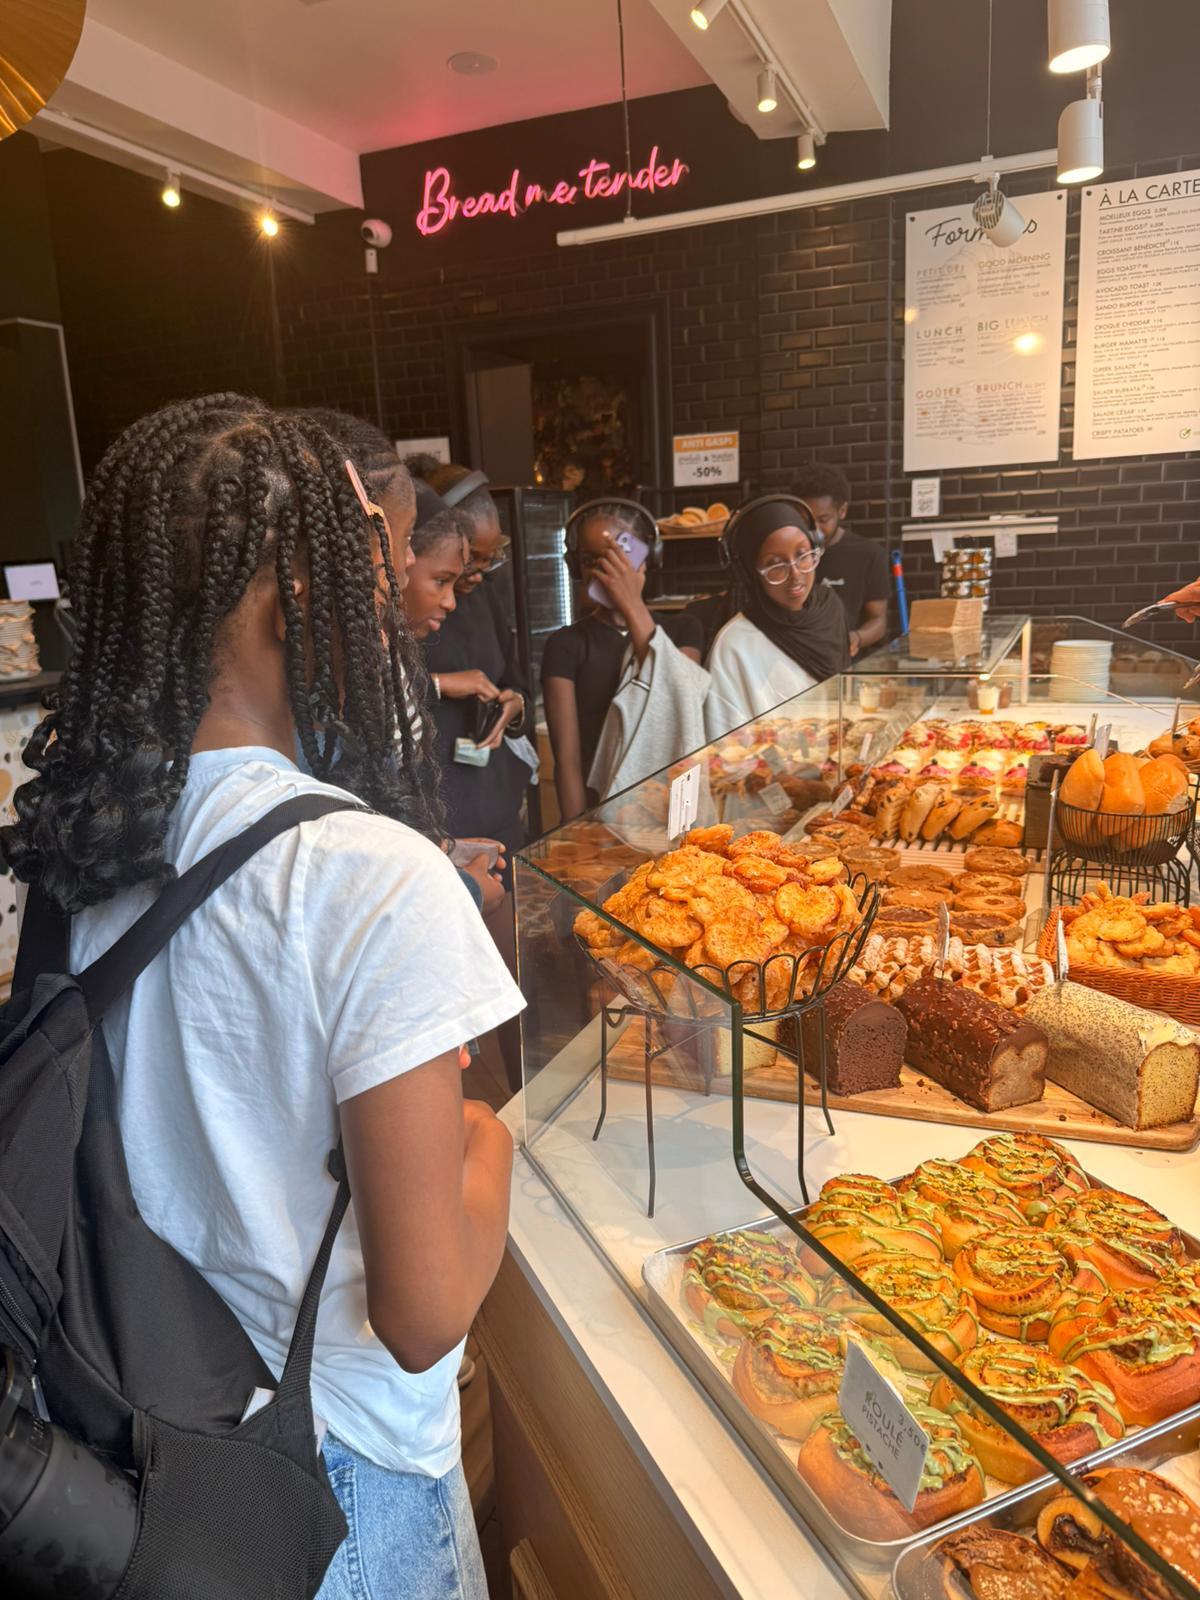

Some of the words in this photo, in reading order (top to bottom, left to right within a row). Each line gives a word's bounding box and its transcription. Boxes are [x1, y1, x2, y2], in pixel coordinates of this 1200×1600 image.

[415, 167, 519, 235] Bread
[525, 181, 576, 206] me
[578, 145, 690, 200] tender
[1100, 188, 1112, 207] À
[1119, 188, 1139, 204] LA
[1145, 178, 1200, 200] CARTE
[1099, 212, 1131, 221] MOELLEUX
[1132, 208, 1151, 217] EGGS
[925, 217, 1038, 247] Forms
[1099, 226, 1123, 235] TARTINE
[1124, 223, 1143, 231] EGGS
[1097, 246, 1132, 256] CROISSANT
[978, 259, 1006, 269] GOOD
[1008, 252, 1051, 264] MORNING
[916, 265, 945, 278] PETIT
[1116, 264, 1136, 272] TOAST
[1096, 285, 1128, 294] AVOCADO
[1129, 282, 1150, 290] TOAST
[1095, 303, 1118, 311] SANDO
[977, 320, 999, 332] BIG
[1094, 322, 1120, 331] CROQUE
[1121, 319, 1150, 327] CHEDDAR
[916, 326, 963, 339] LUNCH
[1093, 341, 1117, 349] BURGER
[1113, 363, 1137, 371] SALADE
[976, 381, 1023, 393] BRUNCH
[1093, 388, 1114, 396] SALADE
[915, 387, 960, 400] GOÛTER
[1092, 429, 1112, 437] CRISPY
[1113, 426, 1144, 434] PATATOES
[681, 440, 704, 449] ANTI
[705, 436, 734, 447] GASPI
[692, 466, 722, 478] -50%
[864, 1391, 905, 1450] ROULÉ
[862, 1403, 900, 1460] PISTACHE
